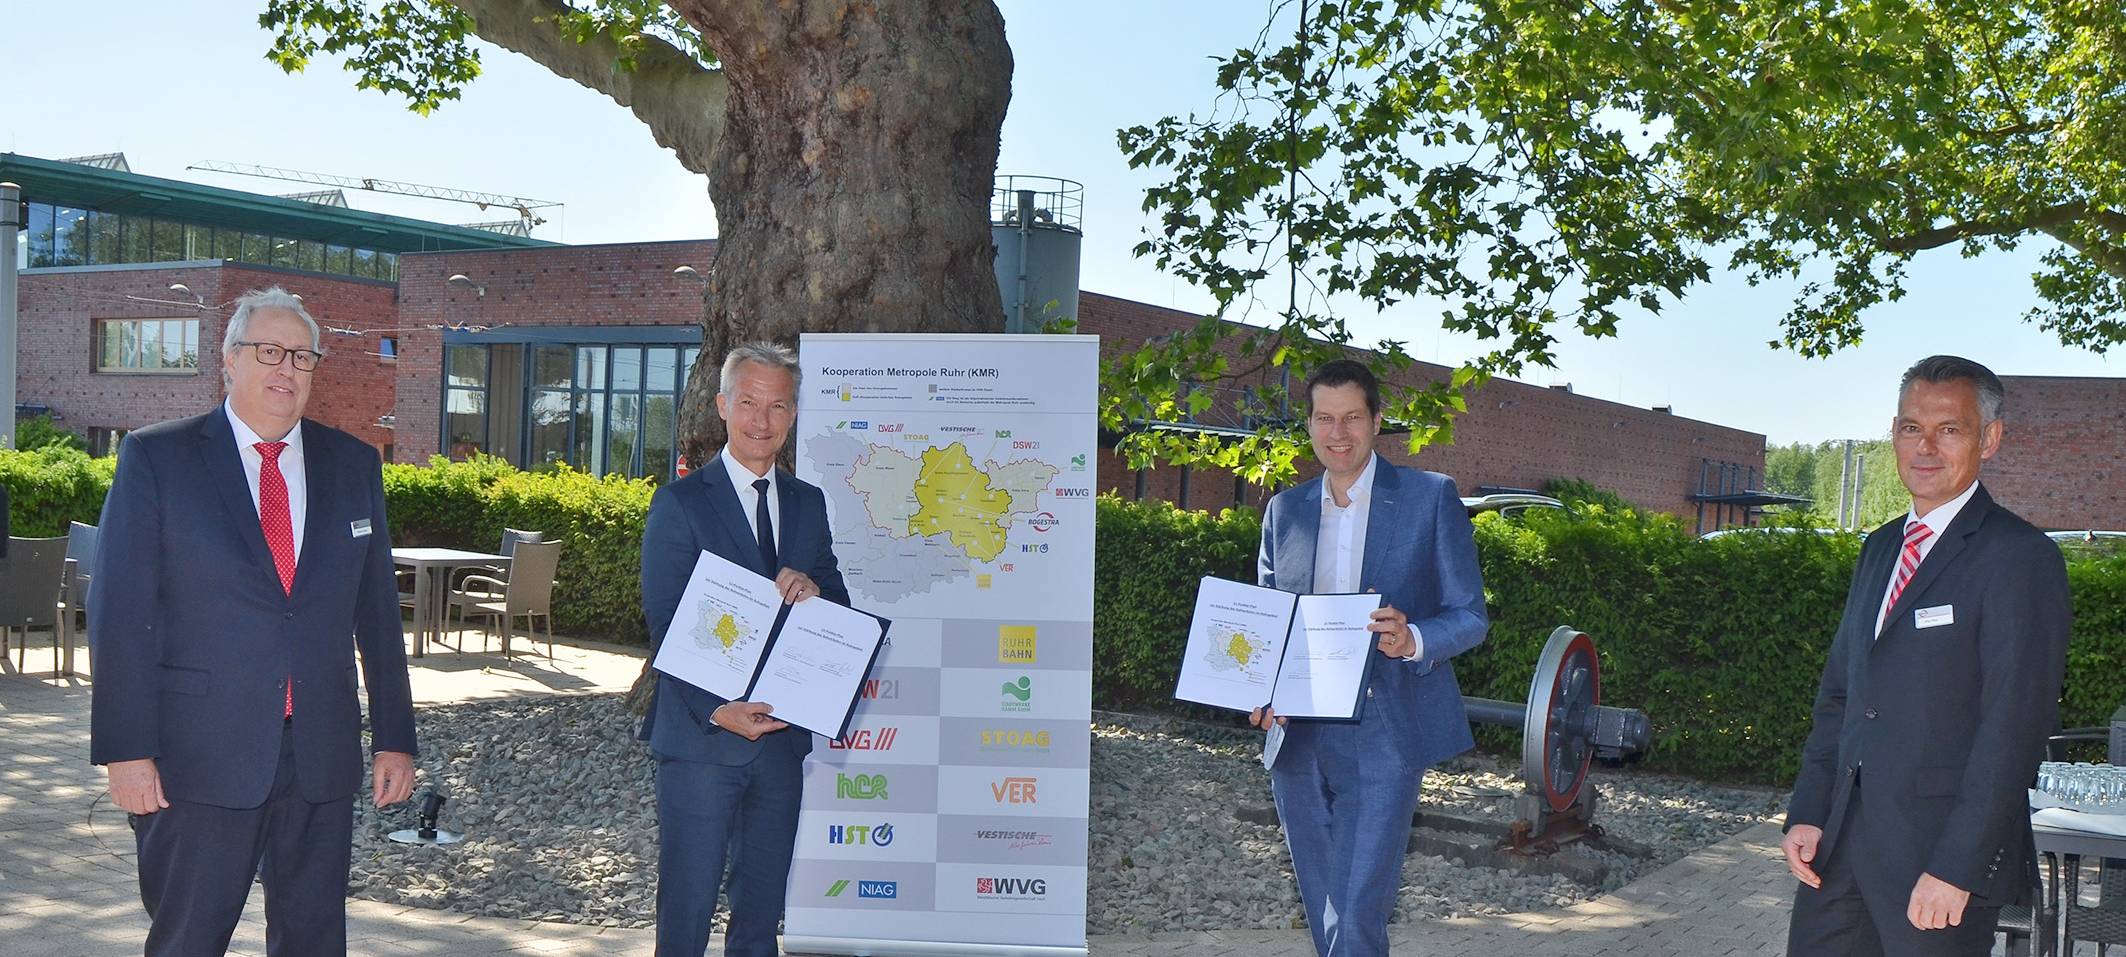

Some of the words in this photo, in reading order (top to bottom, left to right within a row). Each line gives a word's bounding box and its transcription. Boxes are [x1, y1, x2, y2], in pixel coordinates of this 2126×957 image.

[822, 367, 883, 377] Kooperation
[887, 367, 937, 378] Metropole
[940, 368, 965, 377] Ruhr
[968, 368, 999, 379] (KMR)
[1013, 441, 1039, 449] DSW21
[1064, 488, 1089, 497] WVG
[1022, 544, 1039, 553] HST
[1002, 638, 1032, 648] RUHR
[1002, 649, 1032, 658] BAHN
[863, 679, 899, 699] W21
[981, 730, 1051, 747] STOAG
[992, 777, 1037, 803] VER
[829, 825, 870, 844] HST
[977, 830, 1037, 840] VESTISCHE
[861, 884, 894, 896] NIAG
[994, 878, 1046, 895] WVG
